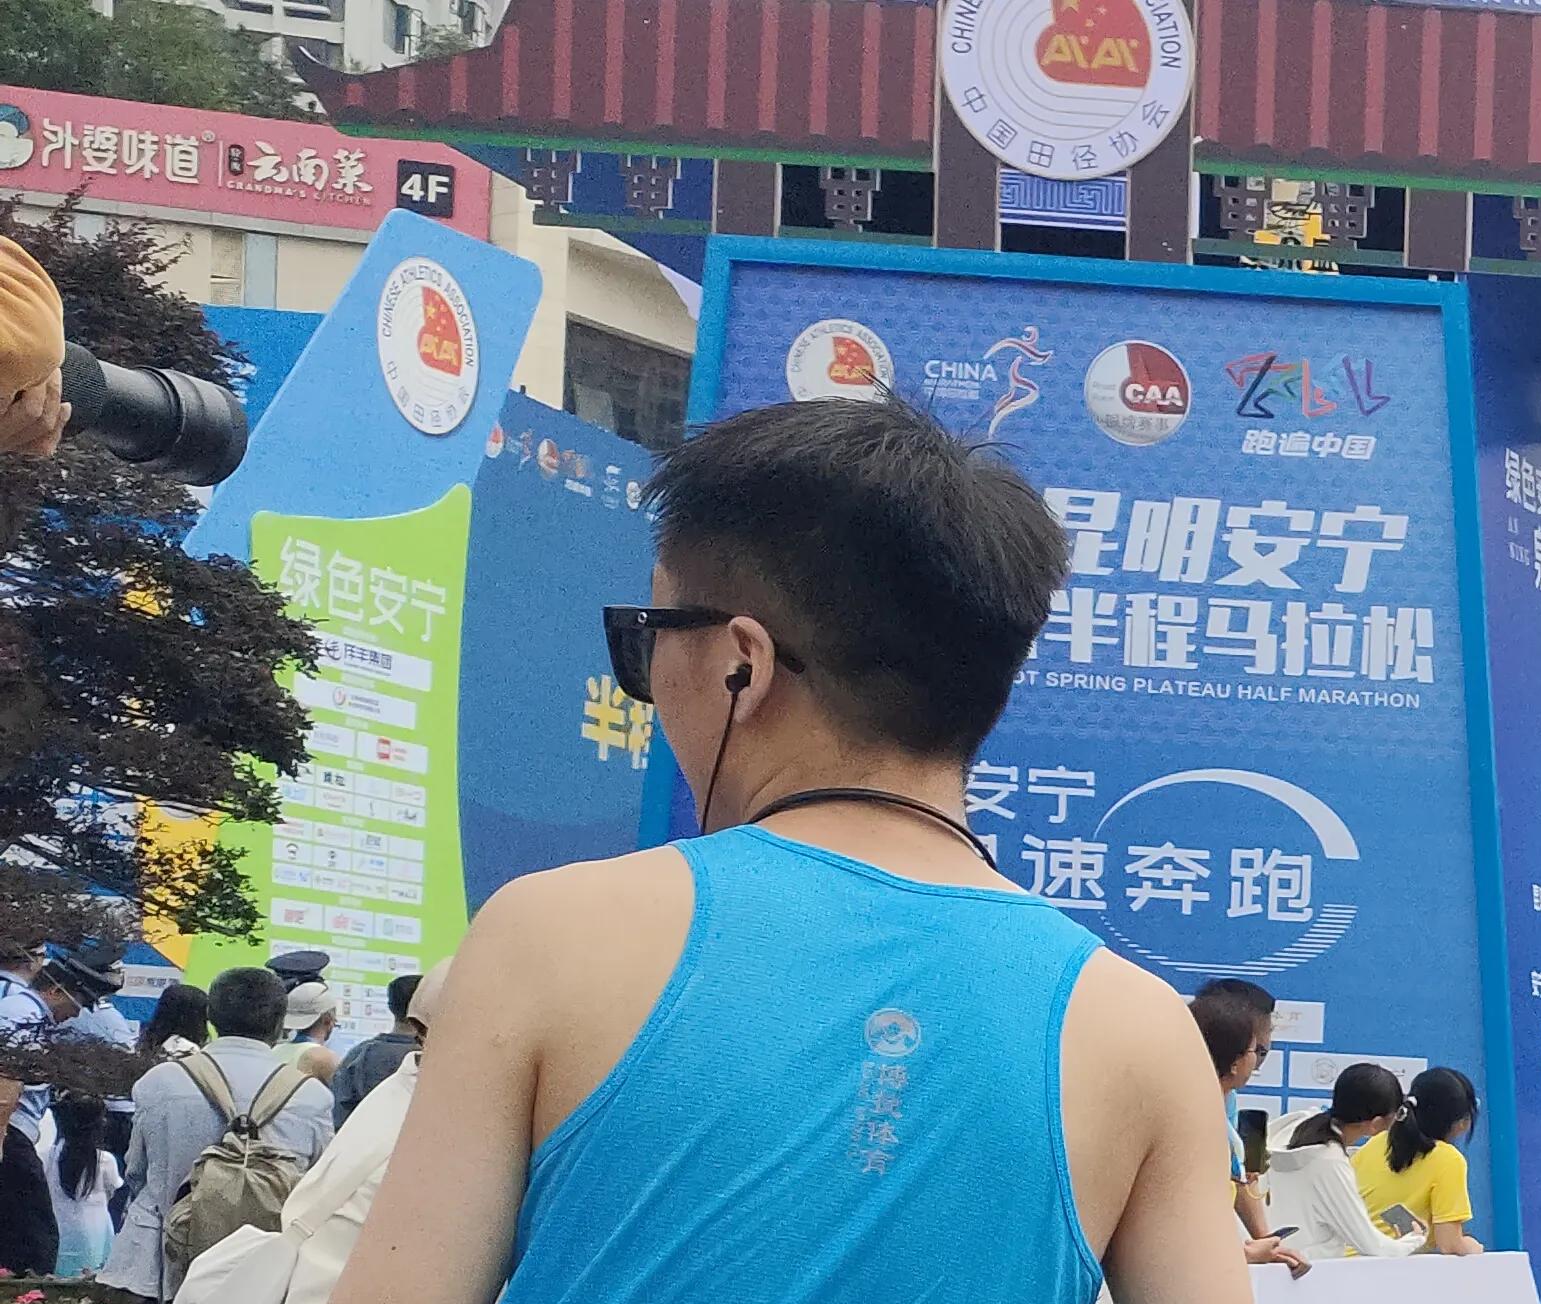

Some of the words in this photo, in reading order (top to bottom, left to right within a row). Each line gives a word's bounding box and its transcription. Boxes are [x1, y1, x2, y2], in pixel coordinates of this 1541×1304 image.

[961, 86, 1170, 171] 中国田径协会
[41, 117, 200, 185] 外婆味道
[247, 140, 374, 194] 云南菜
[400, 173, 451, 204] 4F
[924, 360, 998, 382] CHINA
[1125, 383, 1185, 408] CAA
[1242, 429, 1377, 460] 跑遍中国
[279, 535, 446, 642] 绿色安宁
[1013, 671, 1038, 686] OT
[1045, 672, 1127, 693] SPRING
[1133, 676, 1231, 700] PLATEAU
[1238, 683, 1293, 703] HALF
[1299, 686, 1421, 710] MARATHON
[1018, 832, 1314, 923] 速奔跑
